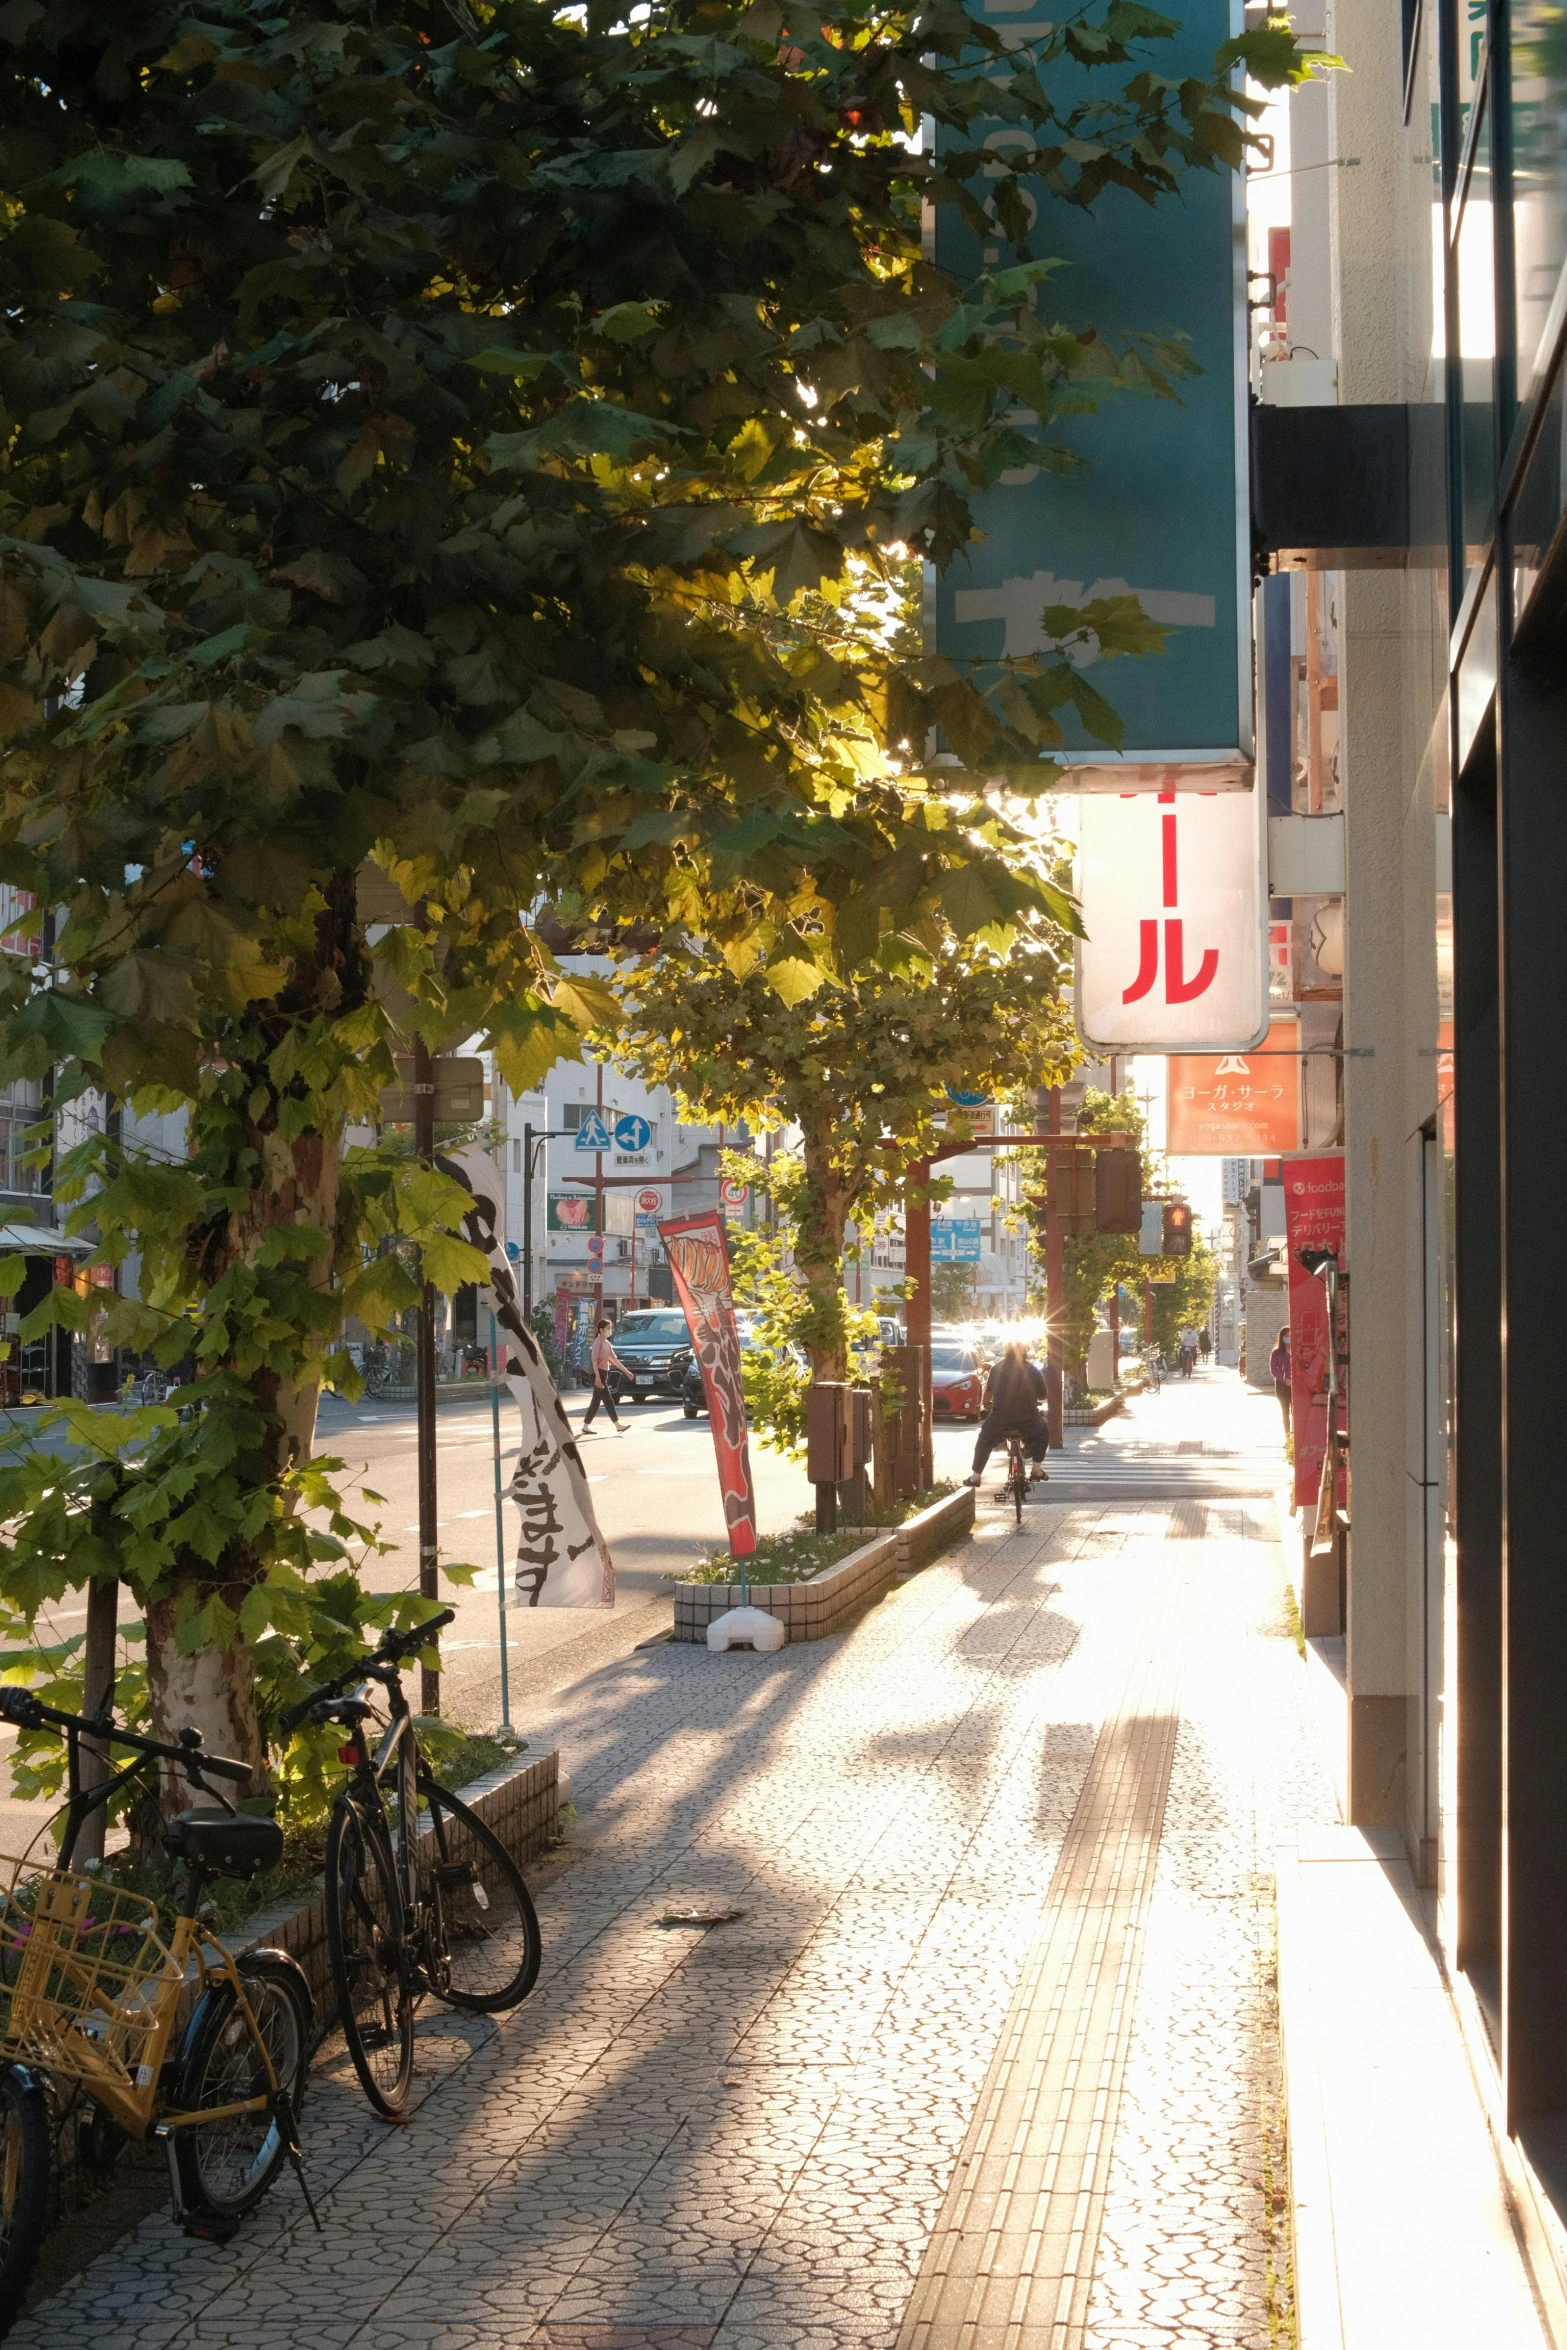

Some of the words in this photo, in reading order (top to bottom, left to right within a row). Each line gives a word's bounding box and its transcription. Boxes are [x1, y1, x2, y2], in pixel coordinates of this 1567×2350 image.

[1118, 792, 1220, 1005] ール
[1183, 1084, 1285, 1100] ヨーガ・サーラ
[1207, 1101, 1256, 1112] スタジオ
[1198, 1121, 1269, 1132] yogasaara.com
[616, 1155, 649, 1165] 軽車両を除く
[728, 1188, 742, 1198] 40
[640, 1196, 658, 1206] 消火栓
